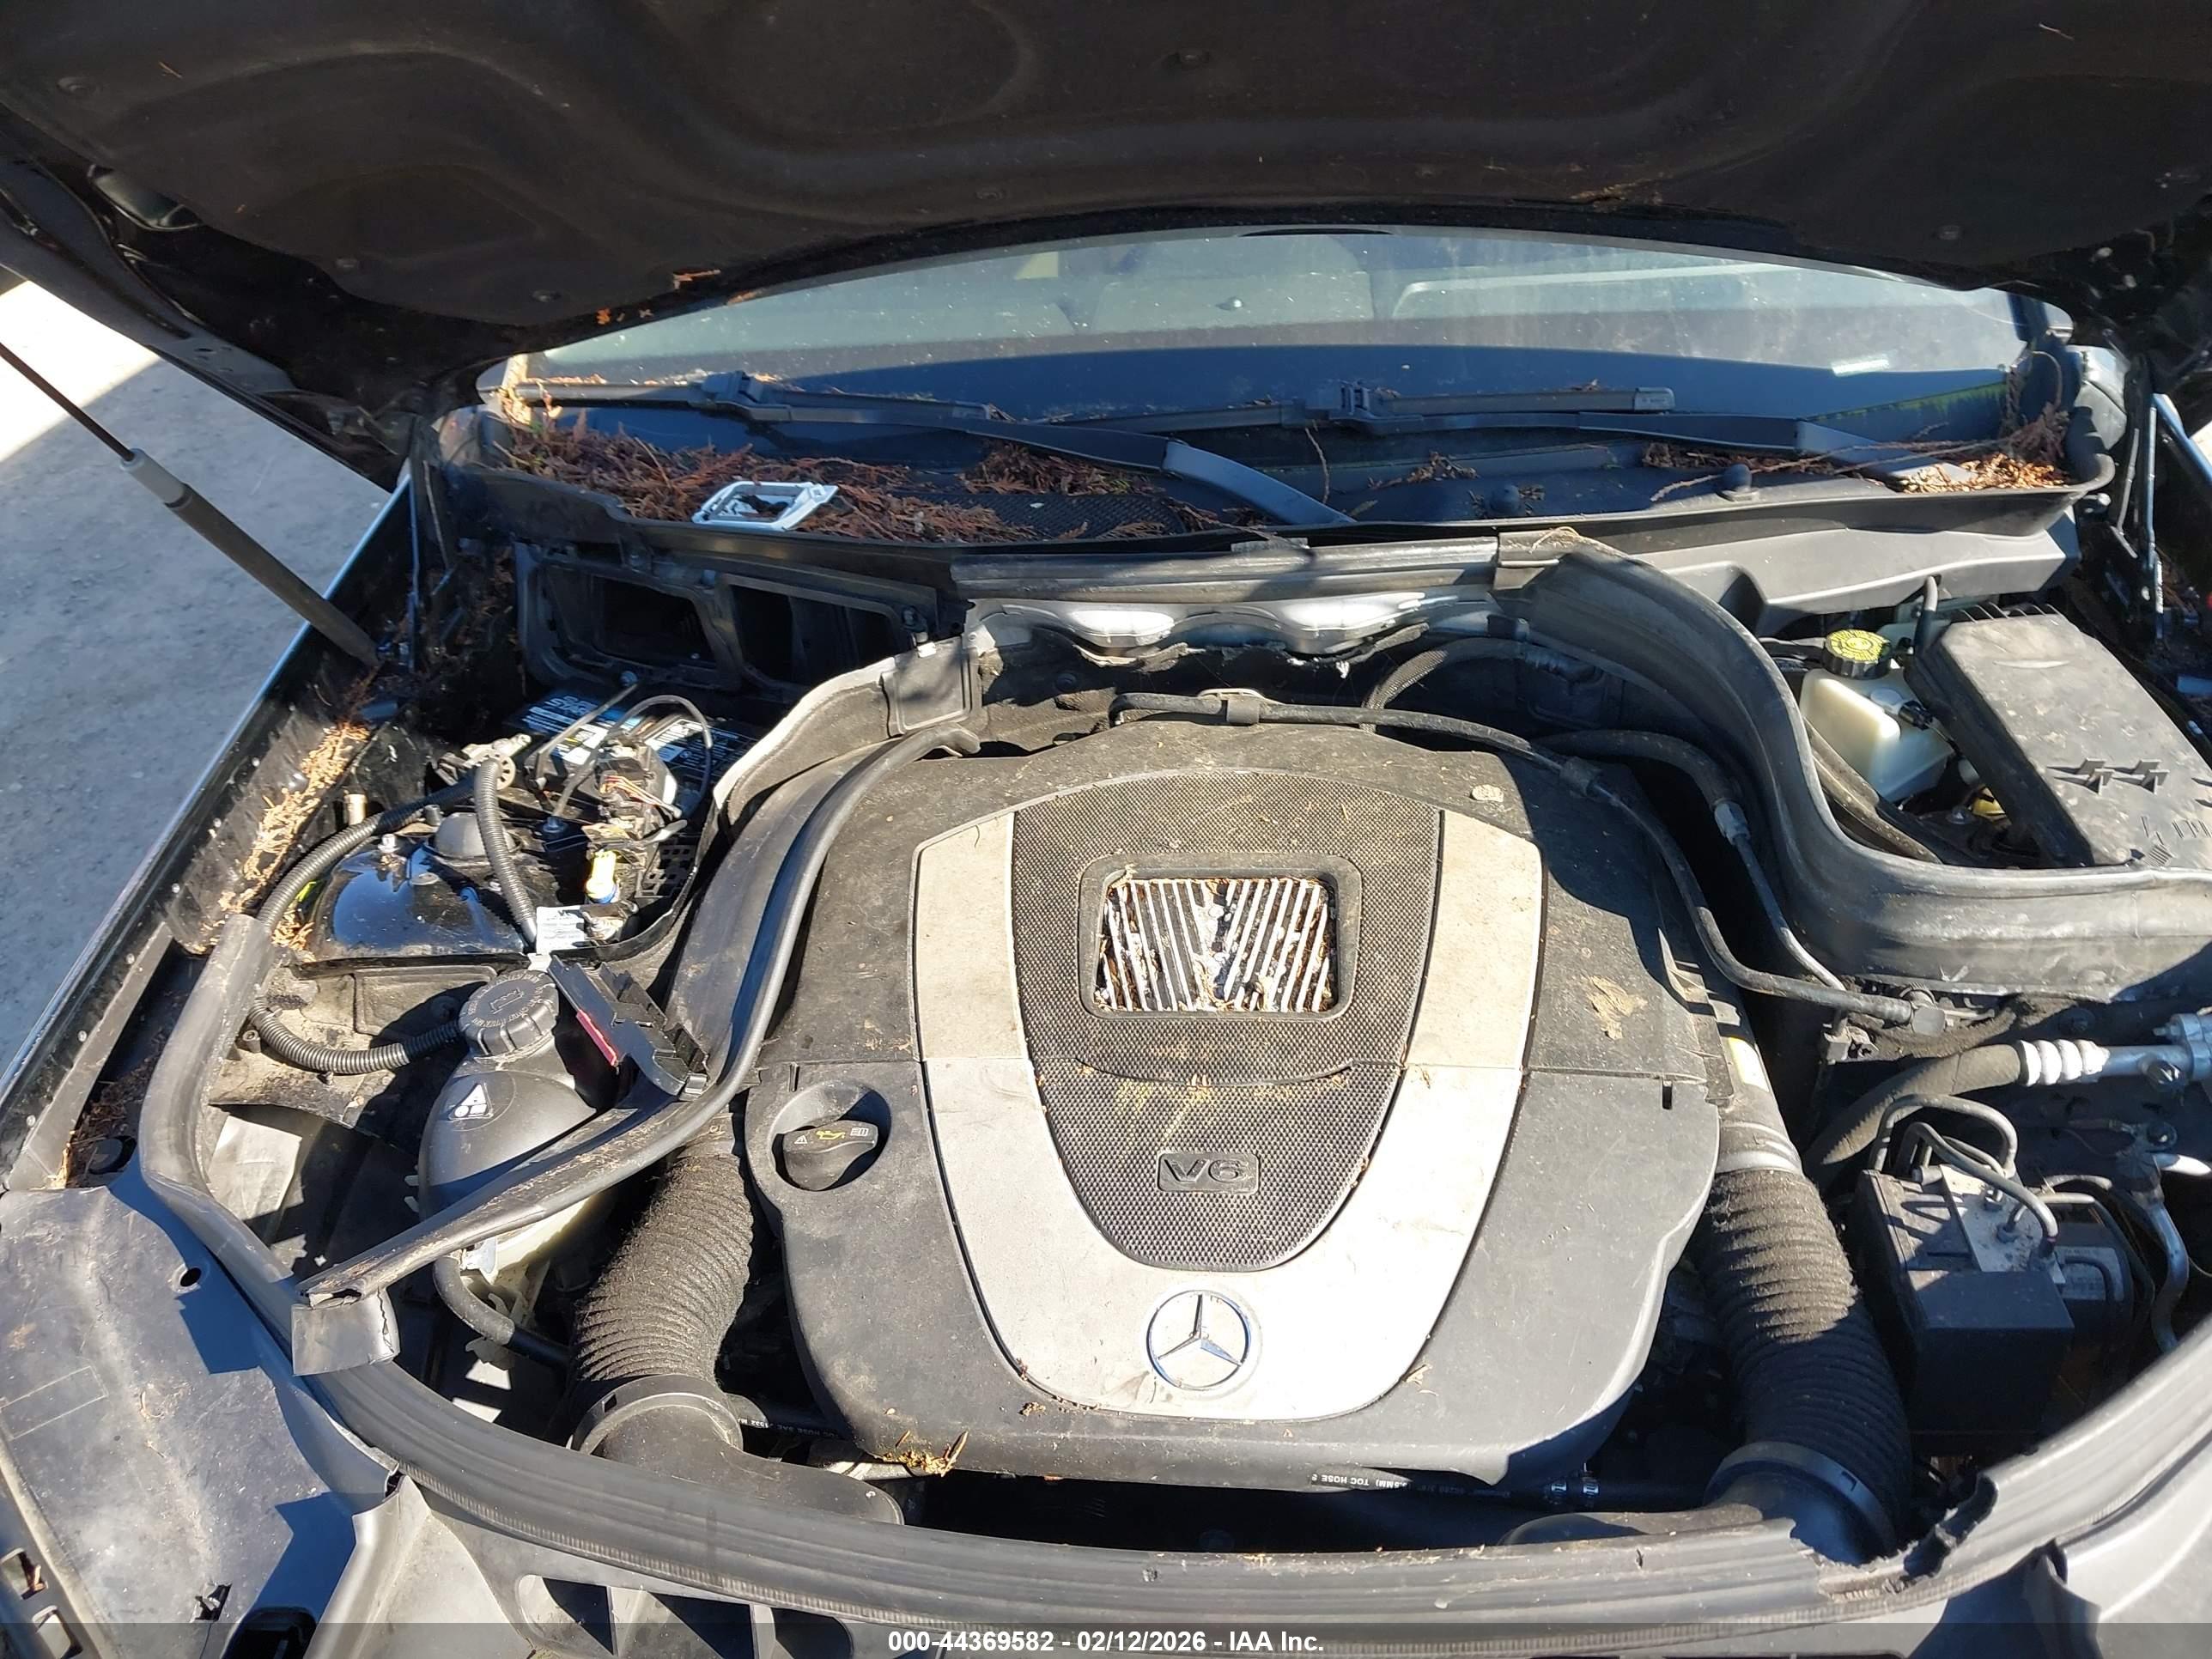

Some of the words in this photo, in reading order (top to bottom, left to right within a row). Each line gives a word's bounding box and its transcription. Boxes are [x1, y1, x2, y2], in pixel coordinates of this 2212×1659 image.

[1164, 1158, 1247, 1183] V6
[1321, 1474, 1348, 1484] HOSE
[1350, 1476, 1370, 1486] TOC
